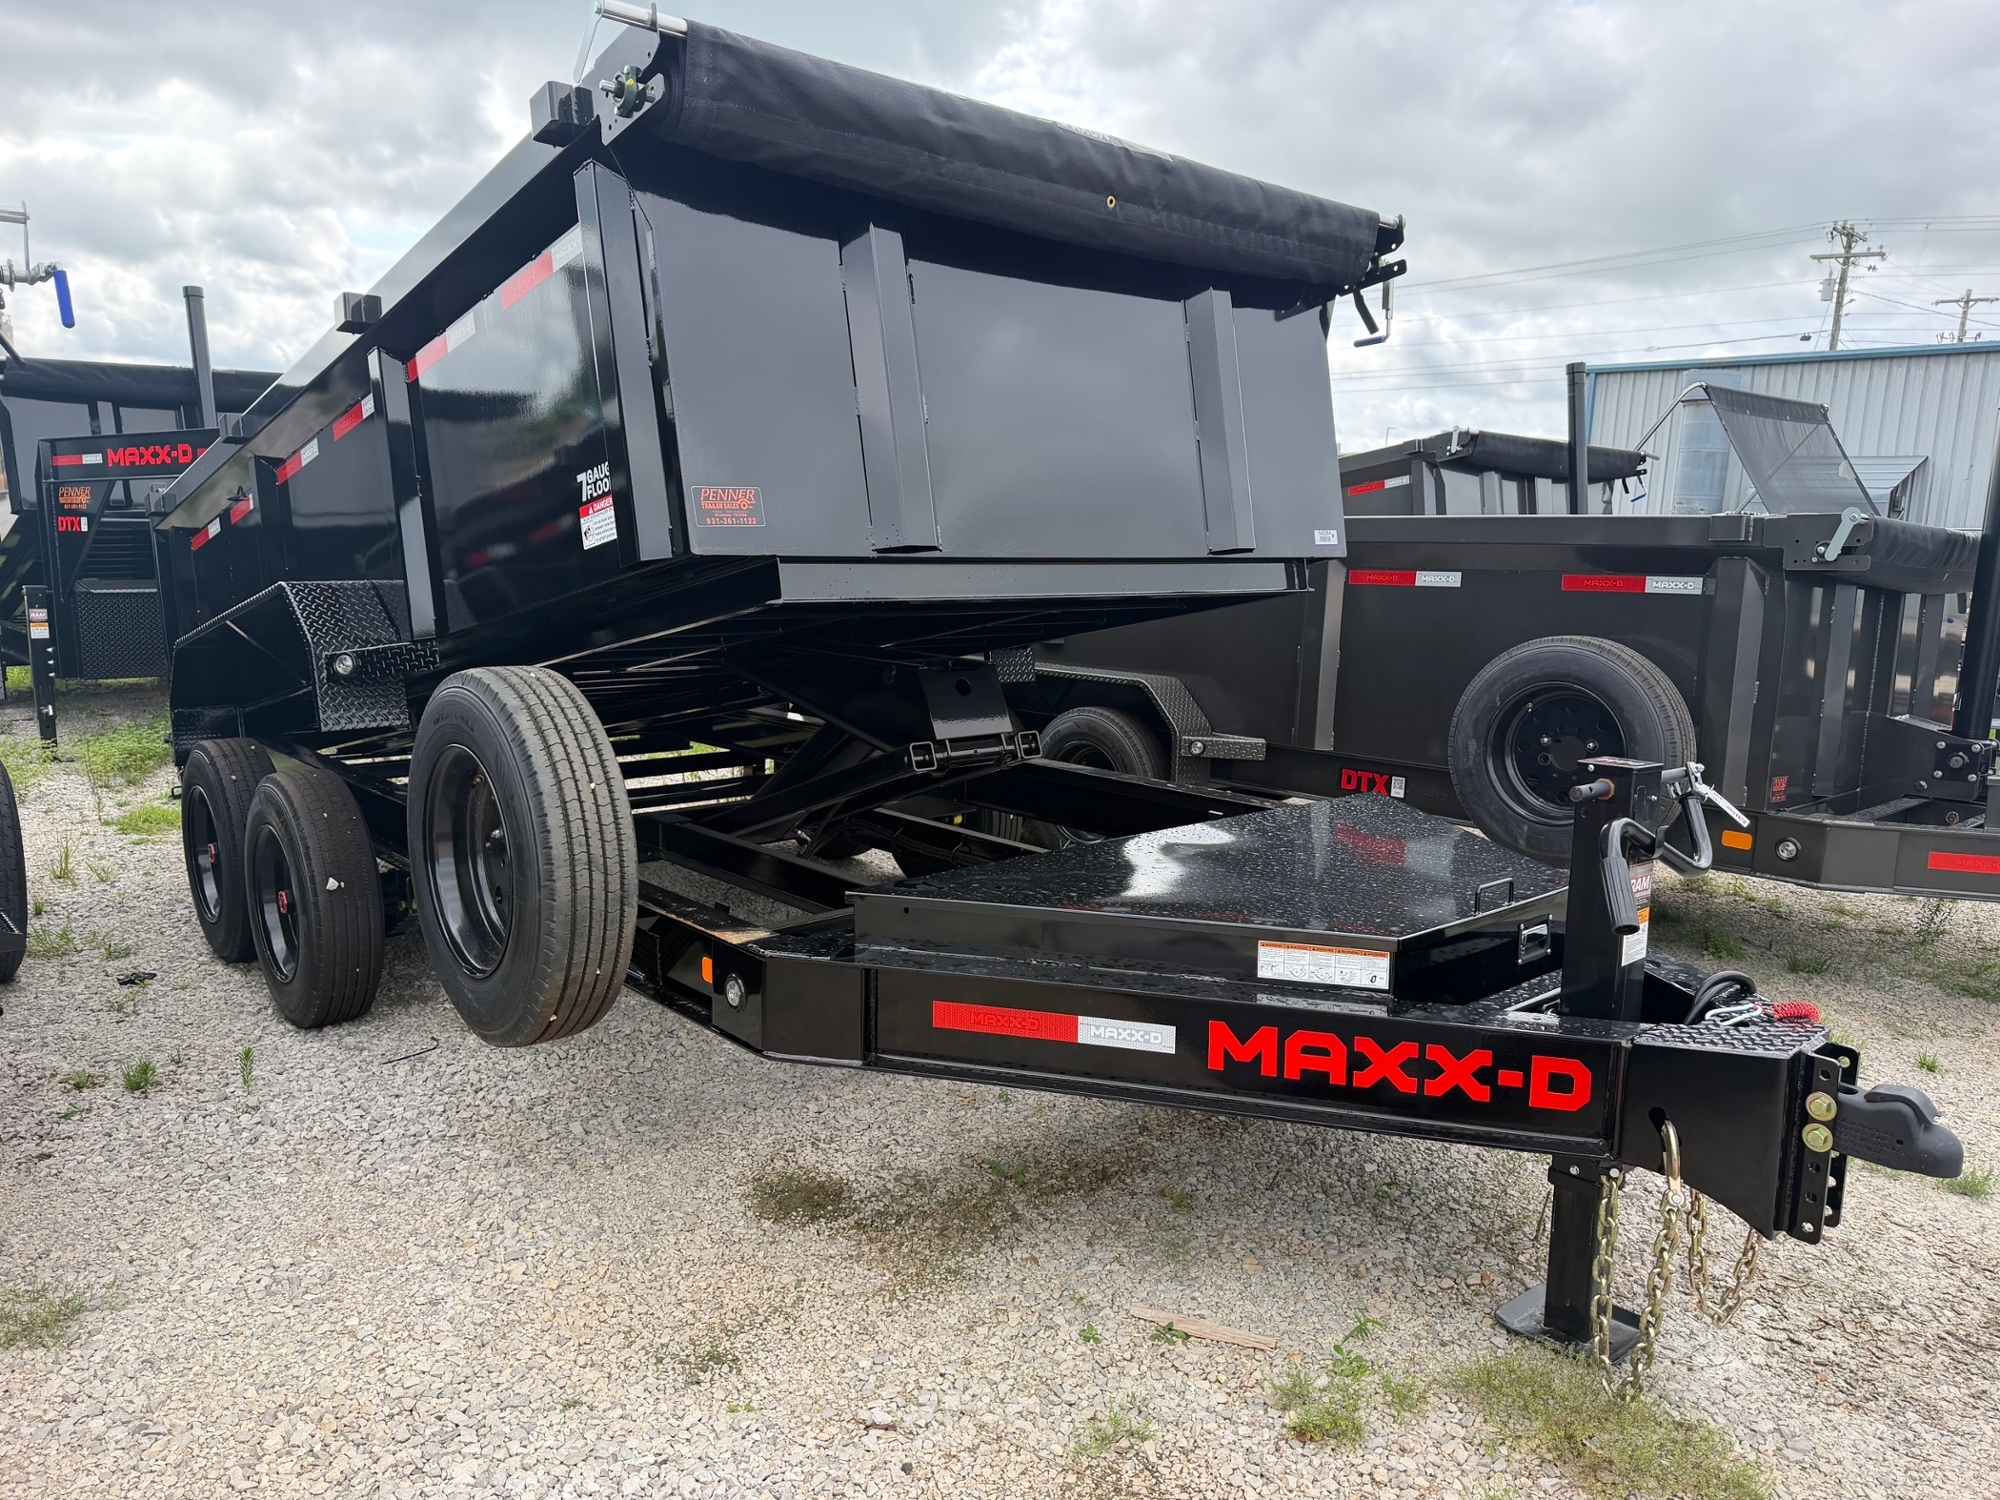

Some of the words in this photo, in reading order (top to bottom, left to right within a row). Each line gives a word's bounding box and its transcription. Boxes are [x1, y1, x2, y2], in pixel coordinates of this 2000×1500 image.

[555, 238, 582, 262] MAXX-
[107, 443, 193, 467] MAXX-D
[576, 471, 588, 502] 7
[587, 461, 610, 484] GAUG
[587, 476, 612, 499] FLOO
[59, 486, 91, 498] PENNER
[701, 488, 755, 502] PENNER
[58, 516, 81, 531] DTX
[706, 517, 757, 525] 931-361-1122
[1421, 575, 1455, 583] MAXX-D
[1584, 579, 1624, 587] MAXX-D
[1652, 581, 1695, 590] MAXX-D
[1341, 769, 1389, 796] DTX
[970, 1012, 1040, 1031] MAXX-D
[1089, 1025, 1162, 1045] MAXX-D
[1207, 1019, 1592, 1112] MAXX-D
